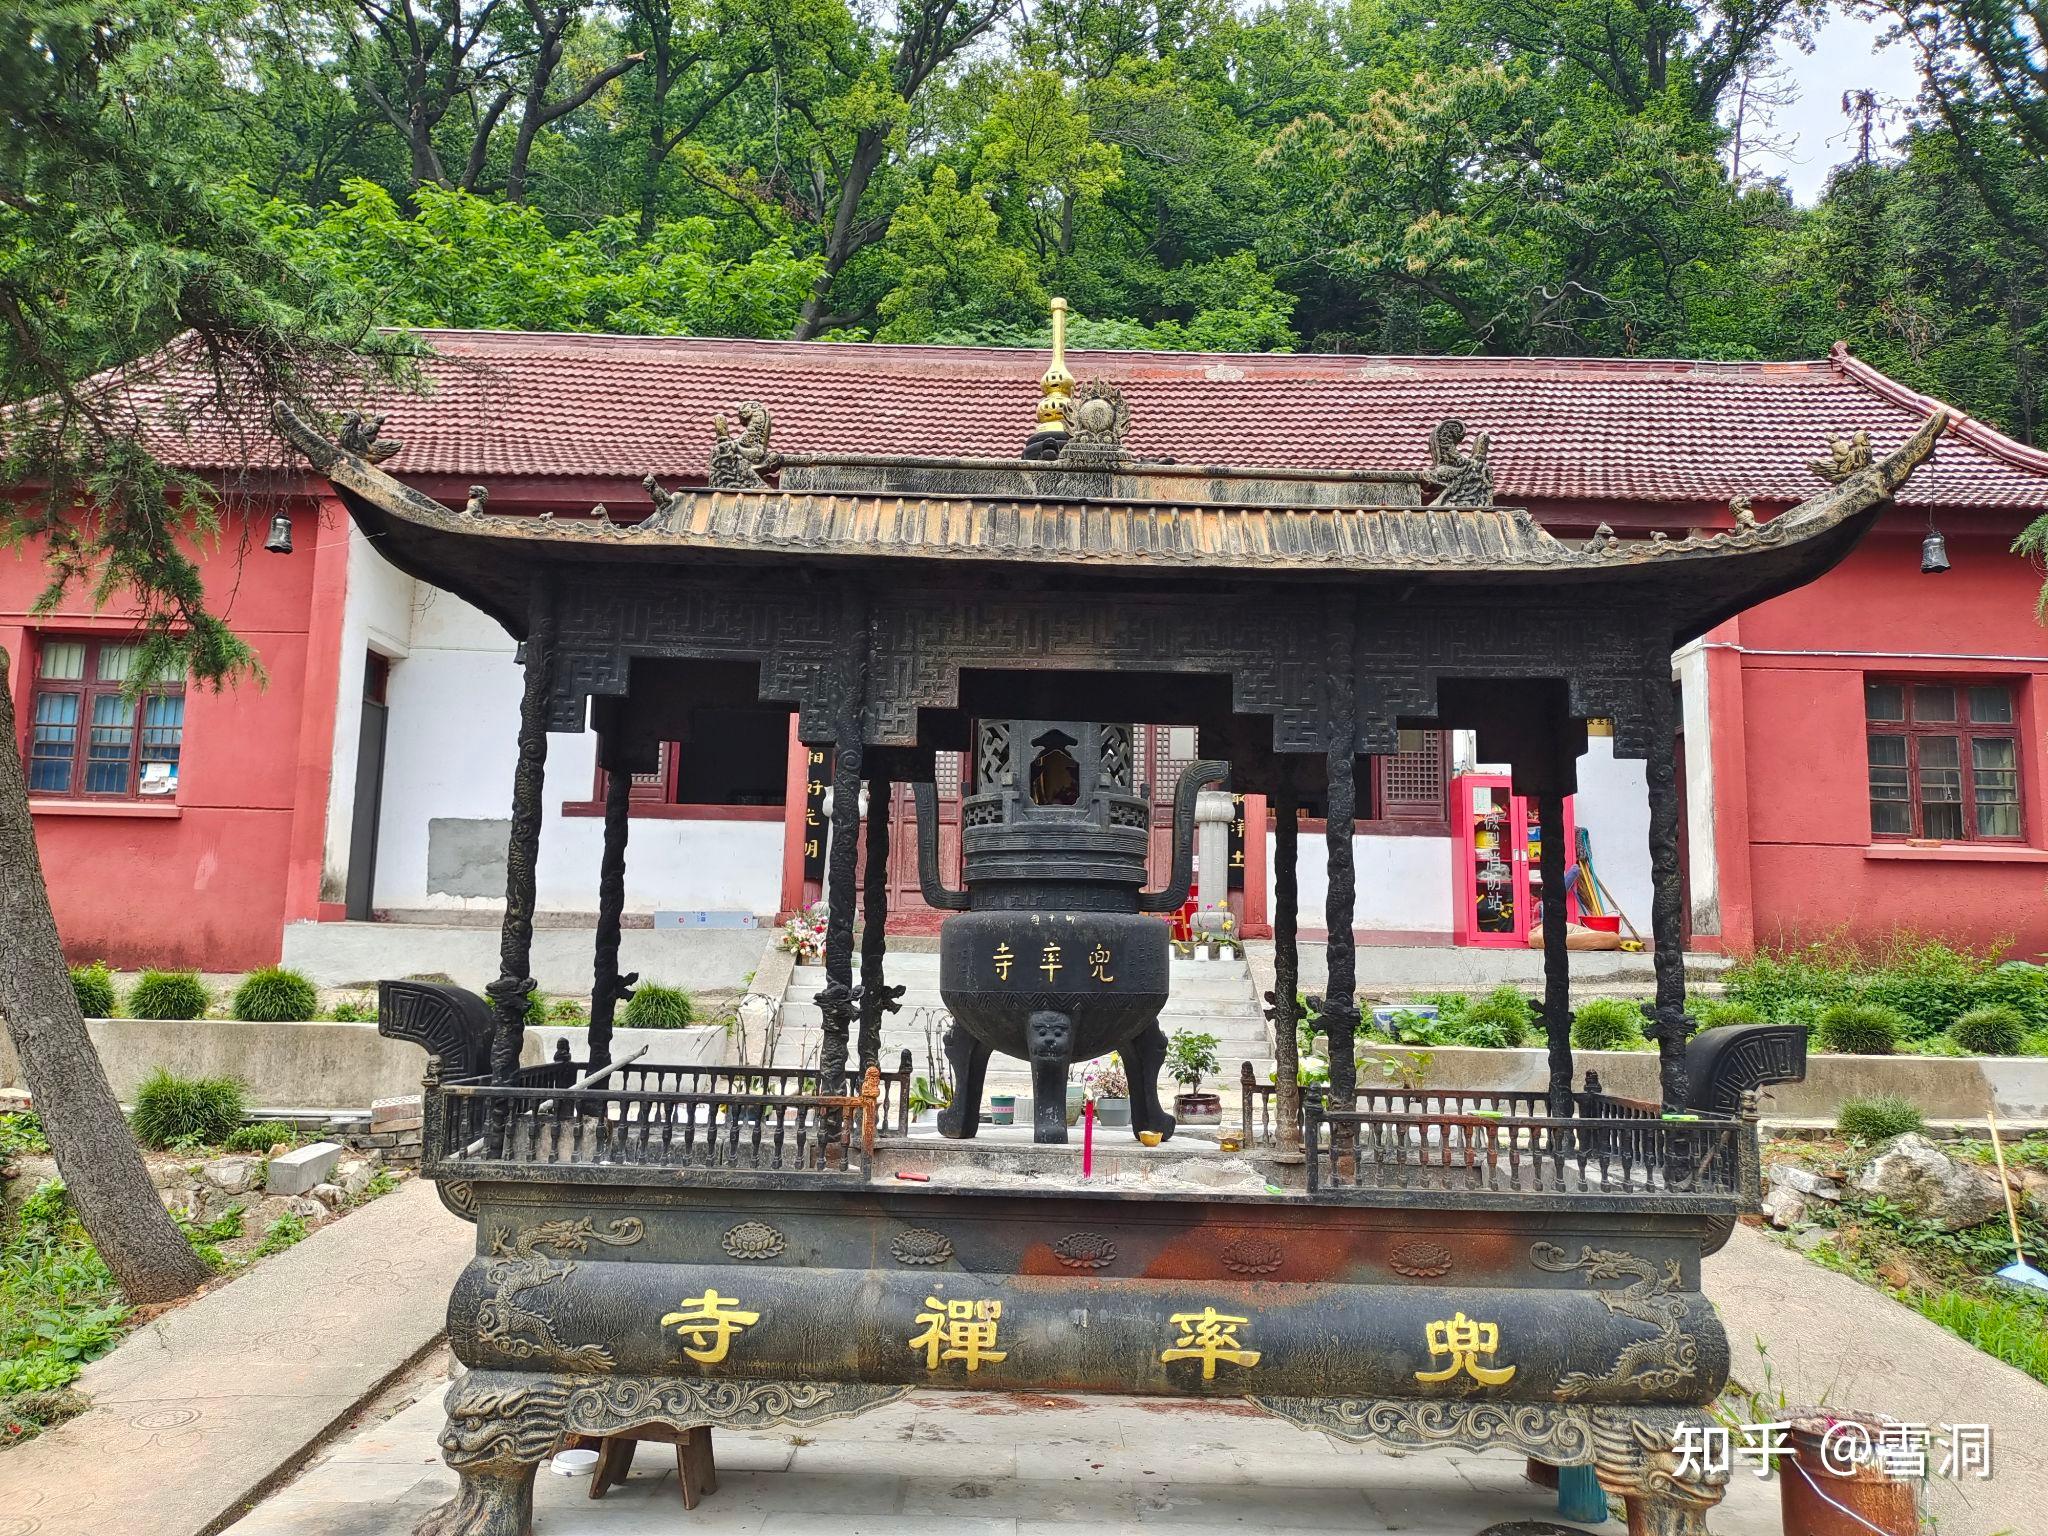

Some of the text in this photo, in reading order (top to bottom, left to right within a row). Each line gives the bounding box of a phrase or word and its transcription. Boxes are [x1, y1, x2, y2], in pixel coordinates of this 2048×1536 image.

[1484, 812, 1503, 911] 微型消防站
